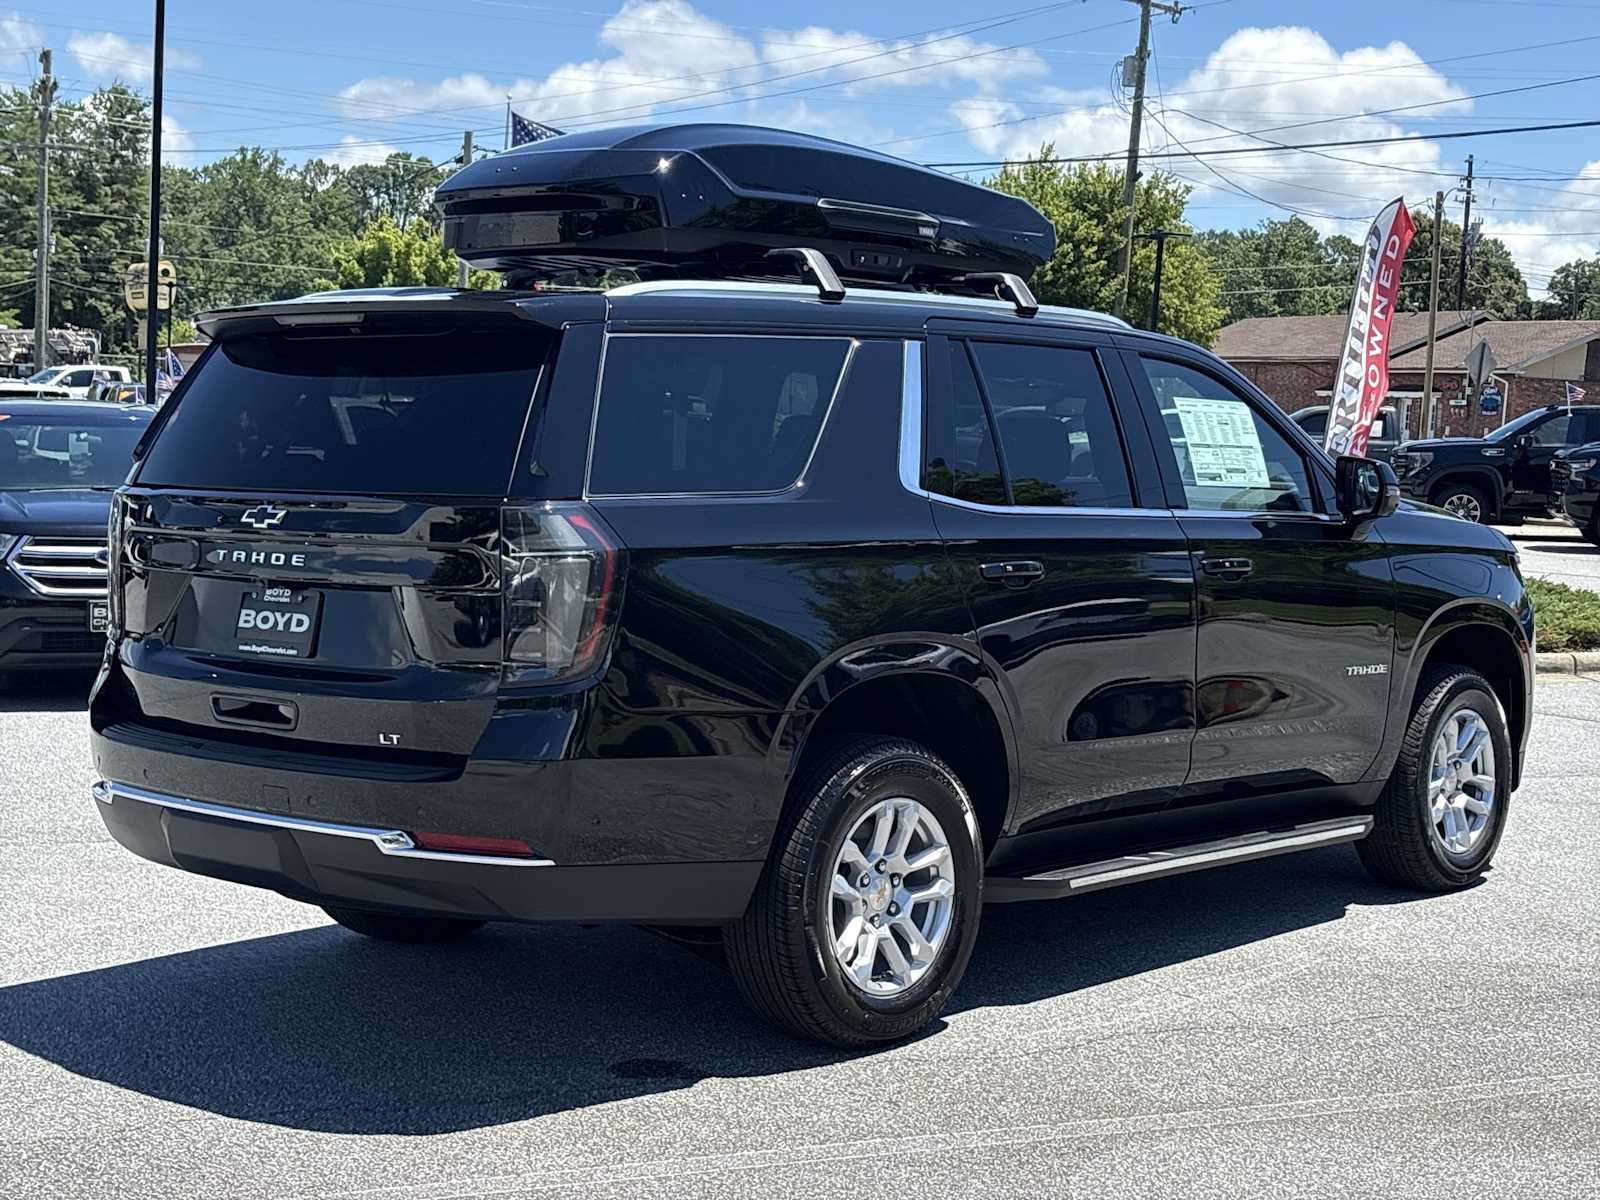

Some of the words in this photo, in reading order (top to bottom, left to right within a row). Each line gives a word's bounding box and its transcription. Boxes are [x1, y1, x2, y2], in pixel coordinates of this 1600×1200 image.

[1326, 224, 1382, 458] ERTIFIED
[1350, 234, 1401, 458] RE-OWNED
[217, 549, 306, 567] TAHOE
[263, 595, 291, 603] Chevrolet
[265, 588, 292, 597] BOYD
[238, 608, 310, 633] BOYD
[1345, 663, 1389, 676] TAHOE
[379, 733, 401, 745] LT
